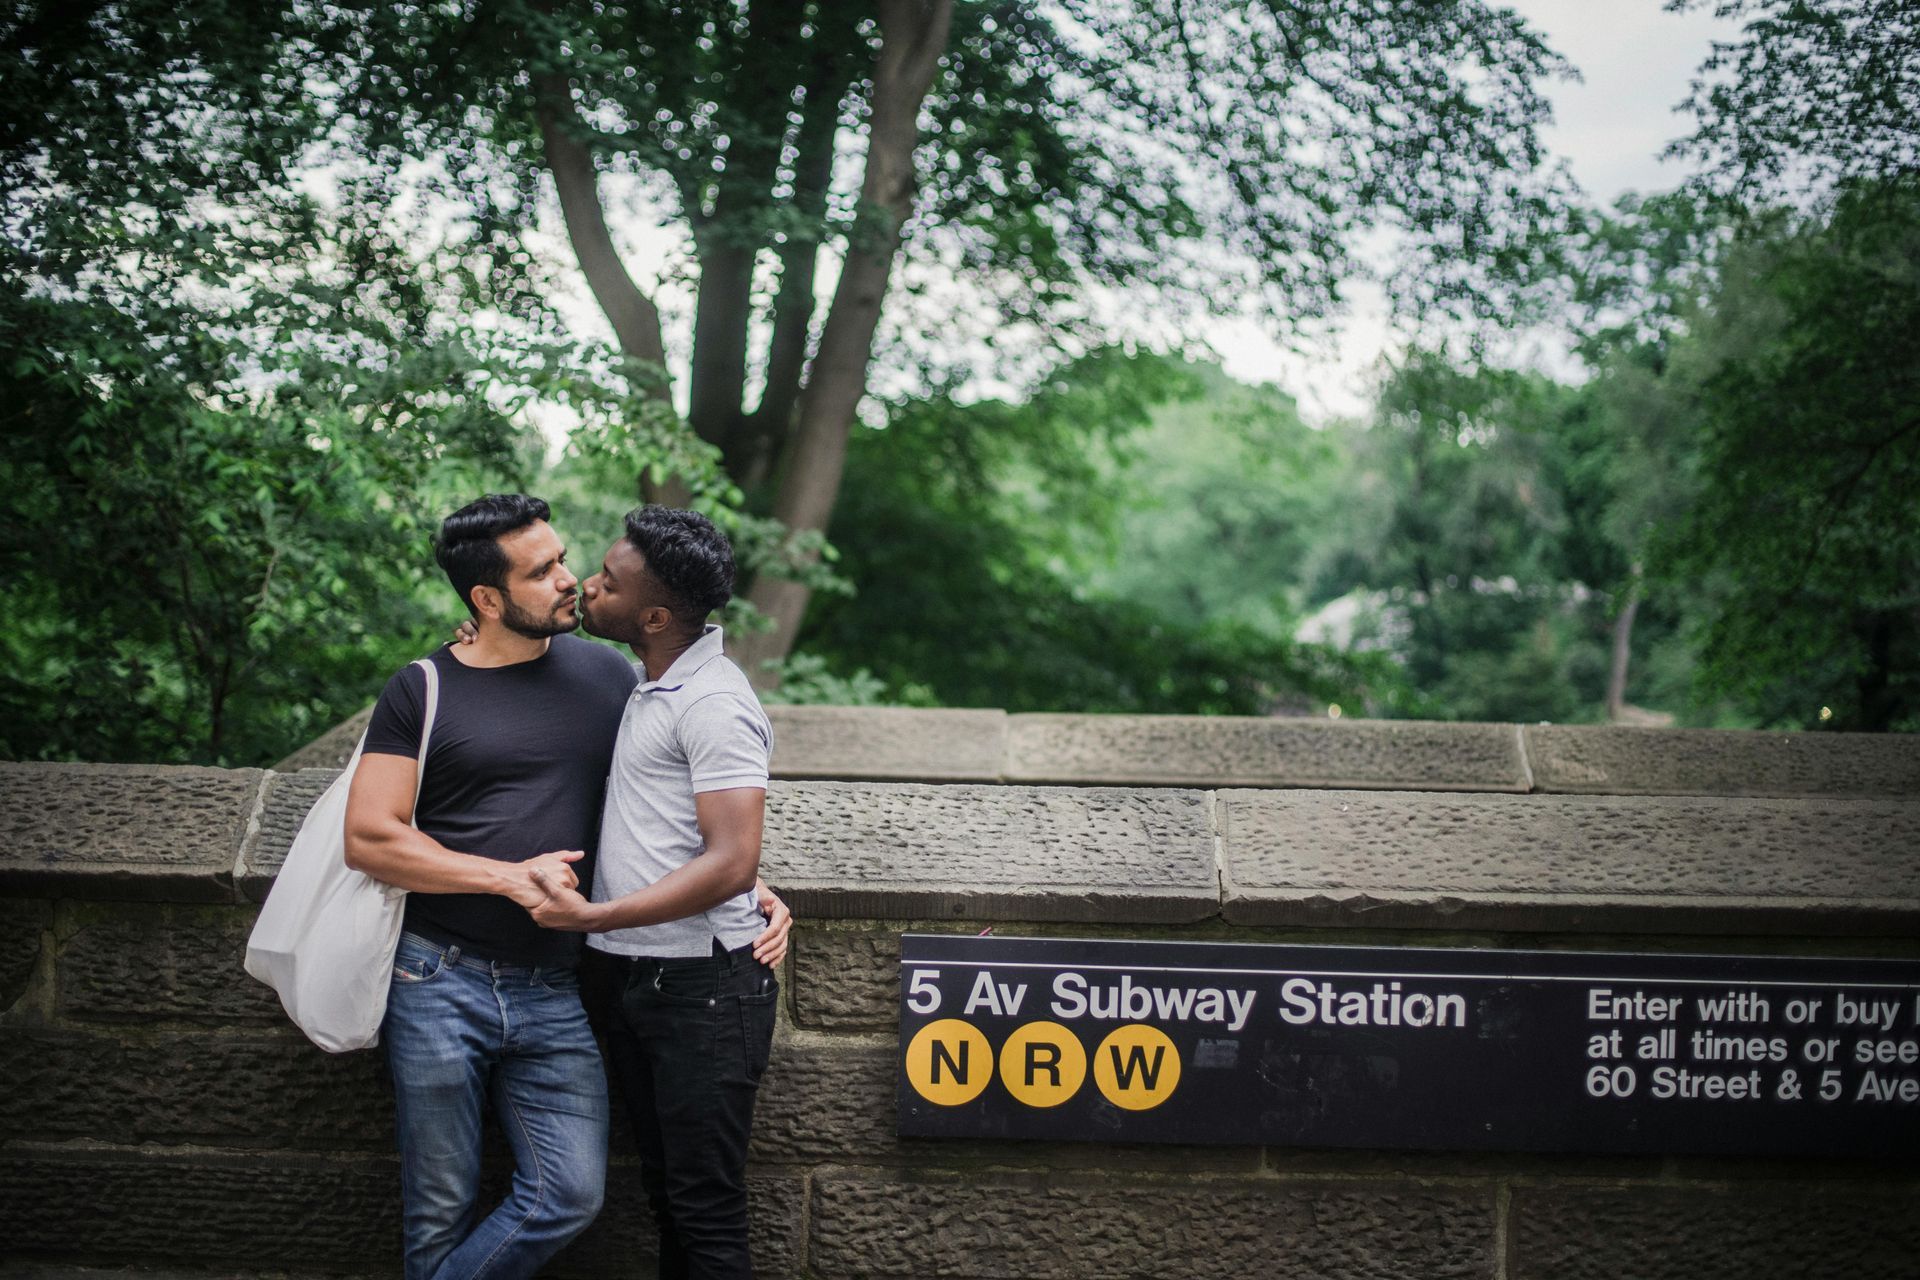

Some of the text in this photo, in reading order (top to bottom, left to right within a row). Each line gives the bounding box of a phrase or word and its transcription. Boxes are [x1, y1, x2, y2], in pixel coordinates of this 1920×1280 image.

[906, 968, 1466, 1032] 5 Av Subway Station
[1587, 988, 1683, 1022] Enter
[1697, 990, 1770, 1023] with
[1784, 999, 1823, 1024] or
[1836, 993, 1901, 1032] buy
[930, 1039, 1166, 1091] N R W
[1586, 1028, 1919, 1064] at all times or see
[1585, 1065, 1920, 1102] 60 Street & 5 Ave
